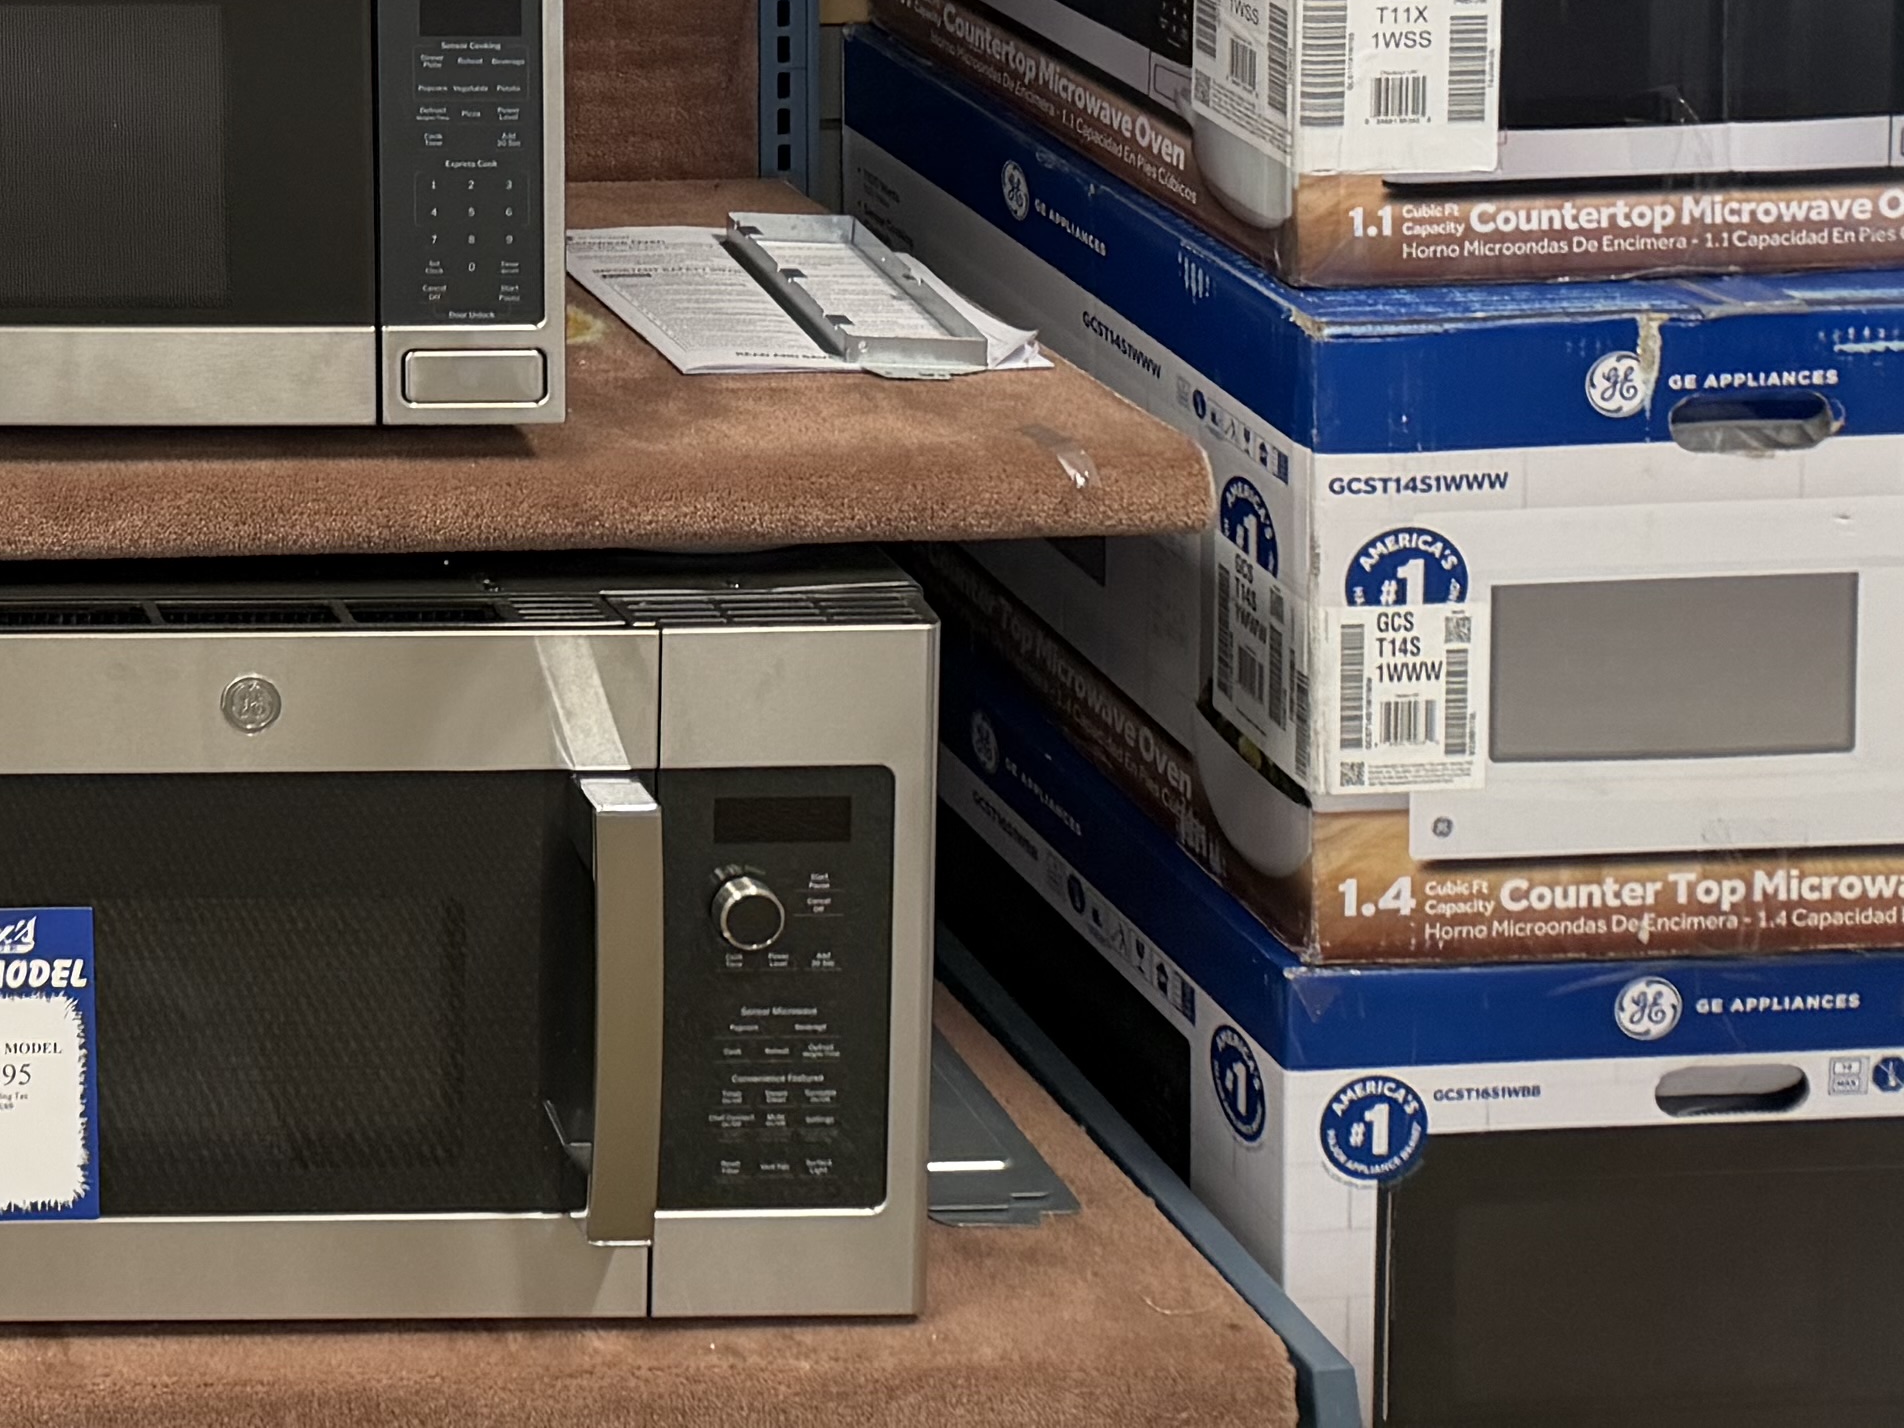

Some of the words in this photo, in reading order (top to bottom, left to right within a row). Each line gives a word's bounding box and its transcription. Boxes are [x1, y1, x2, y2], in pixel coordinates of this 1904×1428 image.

[1376, 6, 1429, 24] T11X
[1371, 30, 1432, 49] 1WSS
[1348, 206, 1392, 237] 1.1
[1470, 198, 1675, 236] Countertop
[1681, 195, 1872, 225] Microwave
[1329, 472, 1509, 496] GCST14S1WWW
[1376, 611, 1414, 633] GCS
[1375, 636, 1421, 658] T14S
[1375, 661, 1443, 683] 1WWW
[1338, 876, 1415, 918] 1.4
[1500, 878, 1662, 911] Counter
[1668, 872, 1747, 910] Top
[5, 1042, 63, 1055] MODEL
